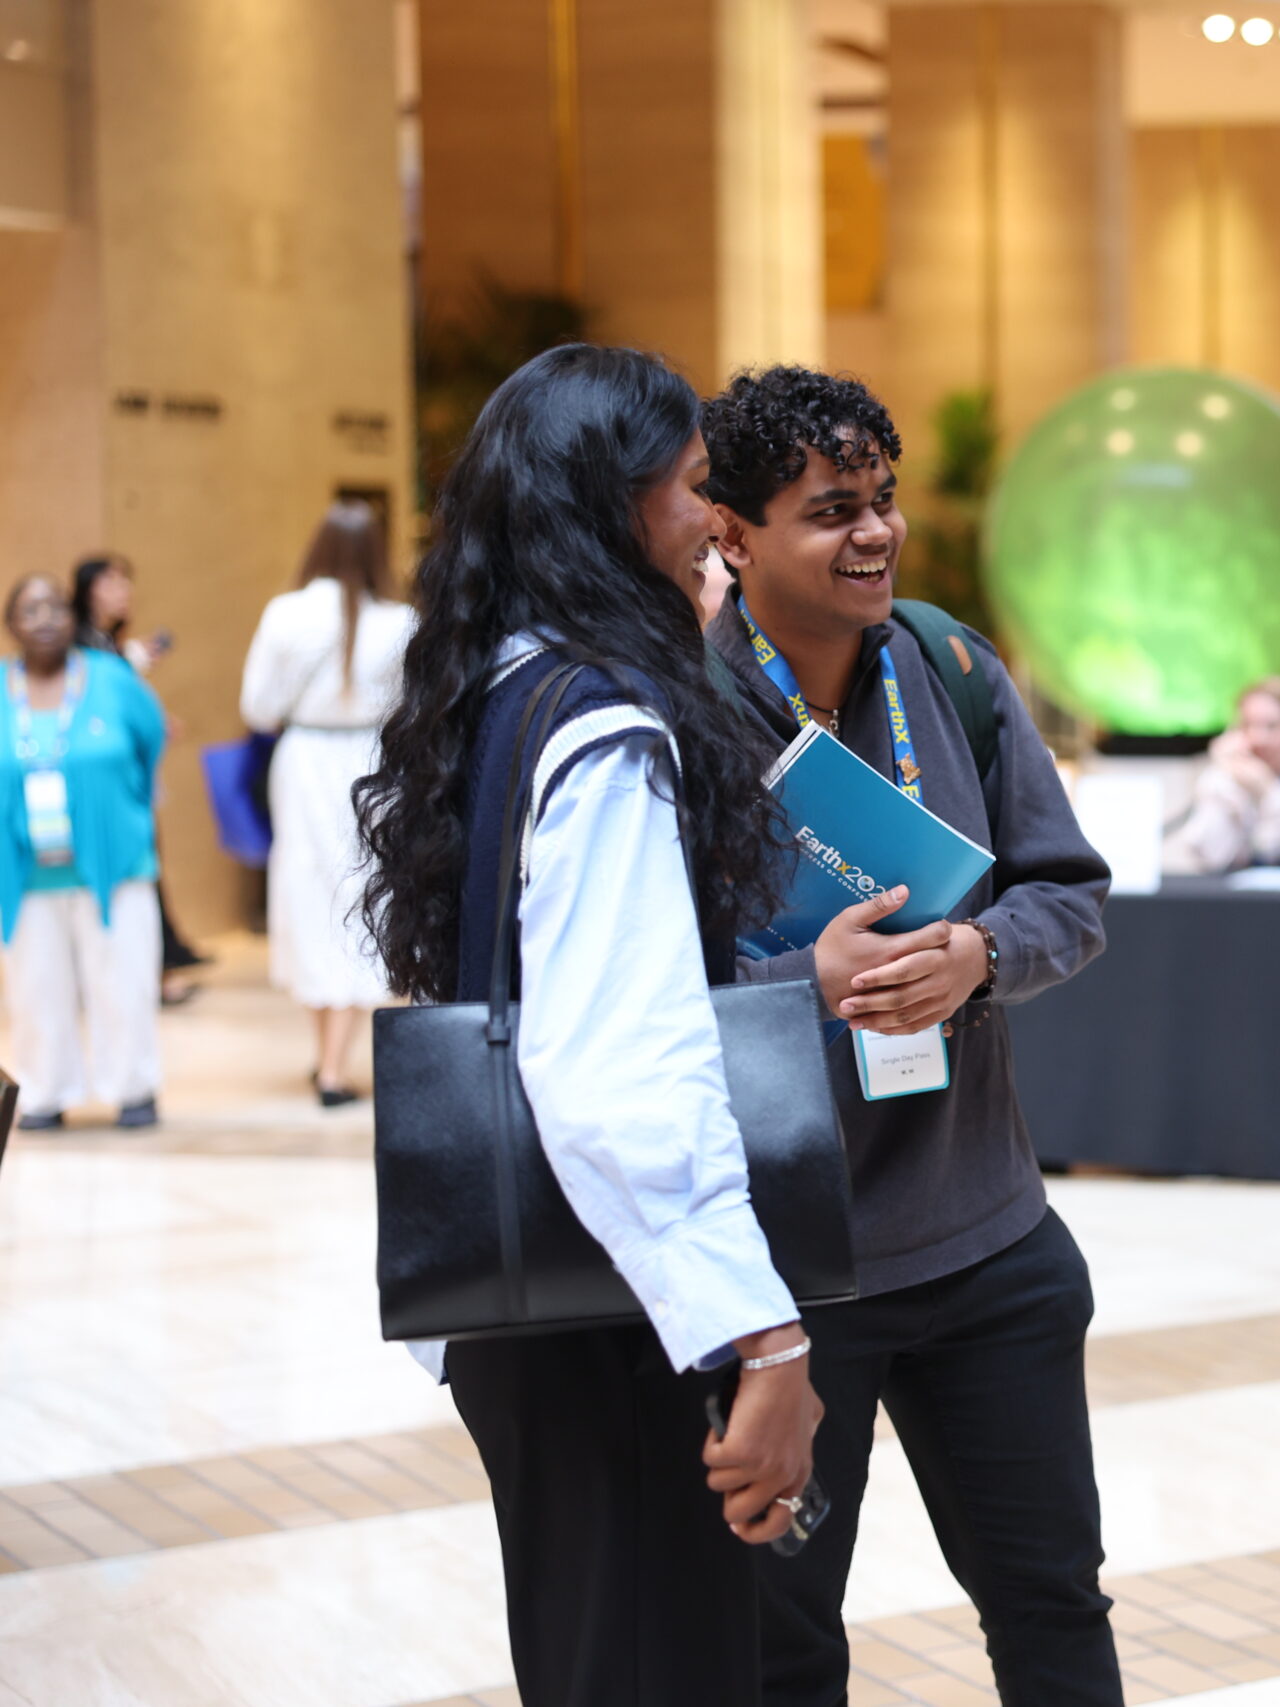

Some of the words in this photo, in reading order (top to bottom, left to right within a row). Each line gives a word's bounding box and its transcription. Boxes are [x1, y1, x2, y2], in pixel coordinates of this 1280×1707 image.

[884, 679, 910, 744] EarthX
[795, 825, 887, 900] Earthx202
[880, 1056, 900, 1065] Single
[901, 1054, 914, 1063] Day
[915, 1052, 931, 1060] Pass
